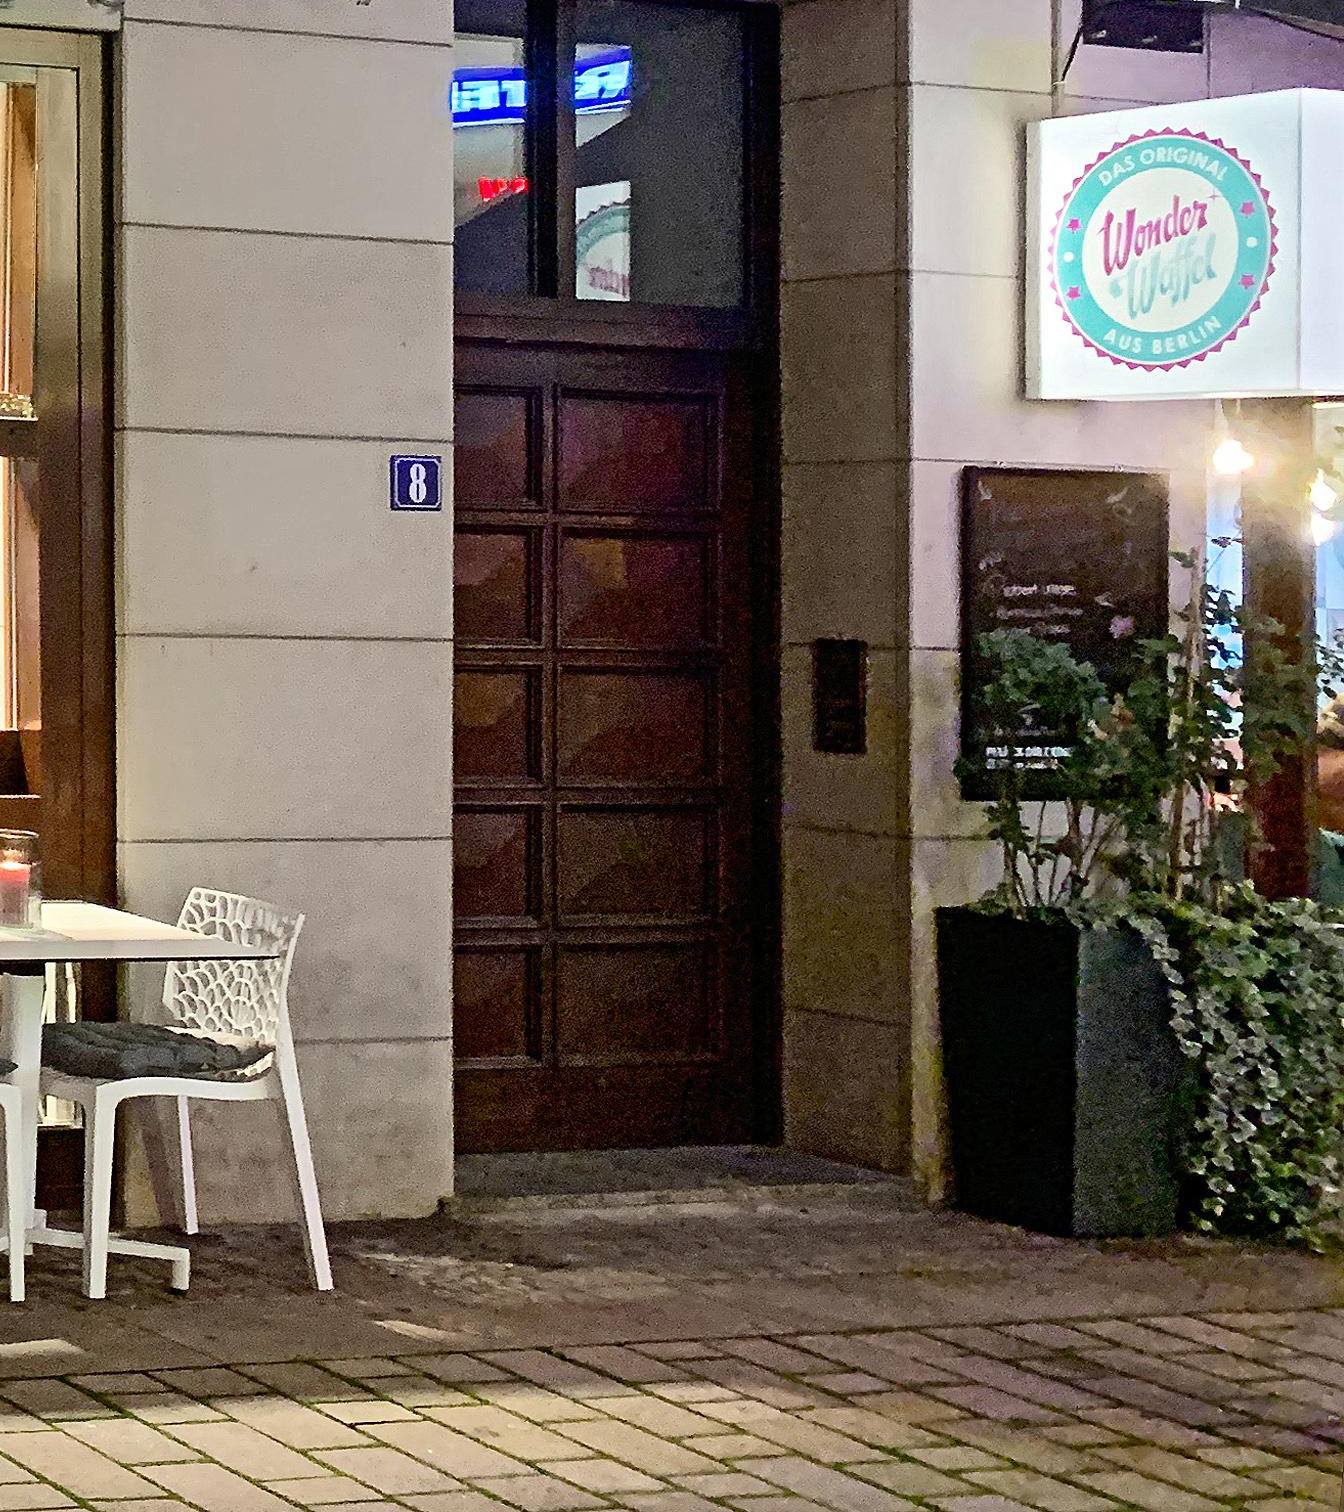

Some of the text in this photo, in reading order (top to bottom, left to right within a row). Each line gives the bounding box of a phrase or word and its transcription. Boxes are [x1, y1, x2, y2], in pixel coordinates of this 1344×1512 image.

[1097, 146, 1229, 186] DAS ORIGINAL
[1097, 194, 1209, 276] Wonder
[1103, 316, 1223, 355] AUS BERLIN
[408, 463, 427, 504] 8
